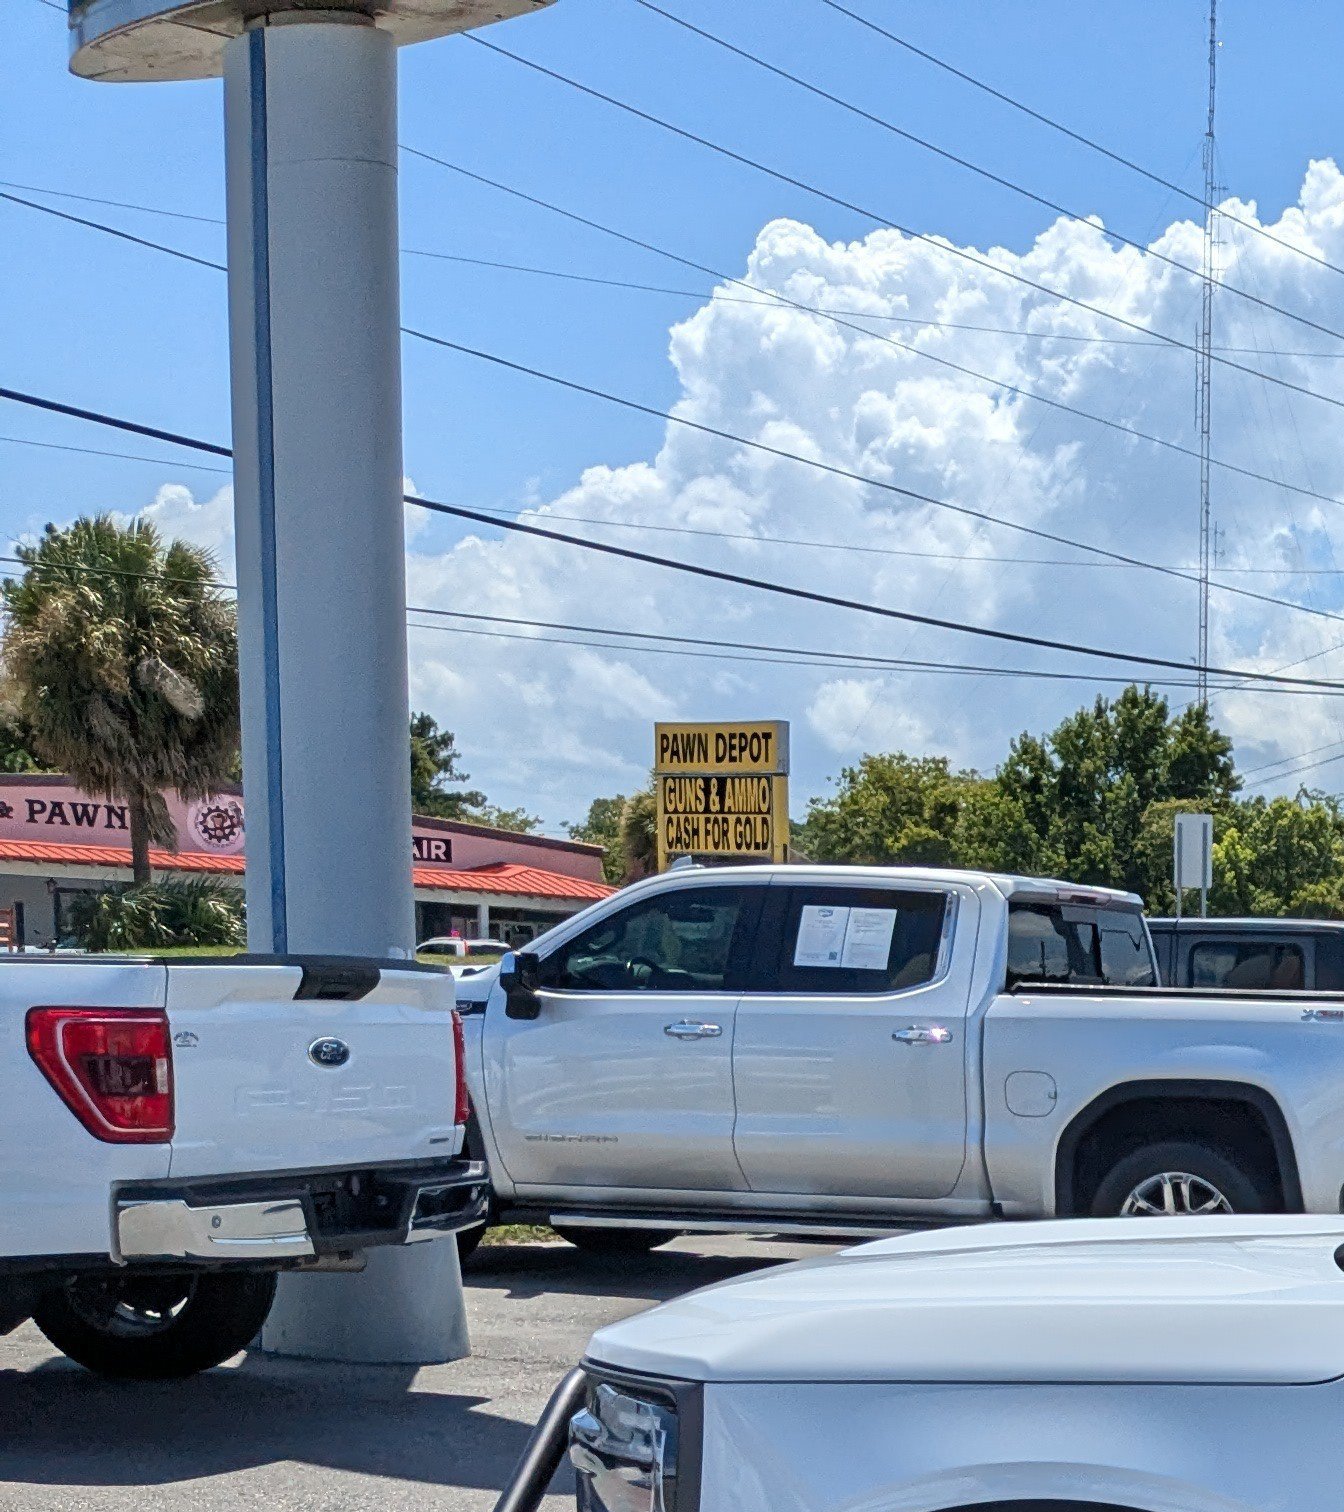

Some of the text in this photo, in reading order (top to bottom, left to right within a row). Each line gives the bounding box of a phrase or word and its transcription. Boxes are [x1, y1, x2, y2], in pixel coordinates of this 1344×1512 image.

[660, 731, 772, 763] PAWN DEPOT
[665, 777, 770, 813] GUNS & AMMO
[25, 798, 129, 830] PAWN
[666, 815, 770, 851] CASH FOR GOLD
